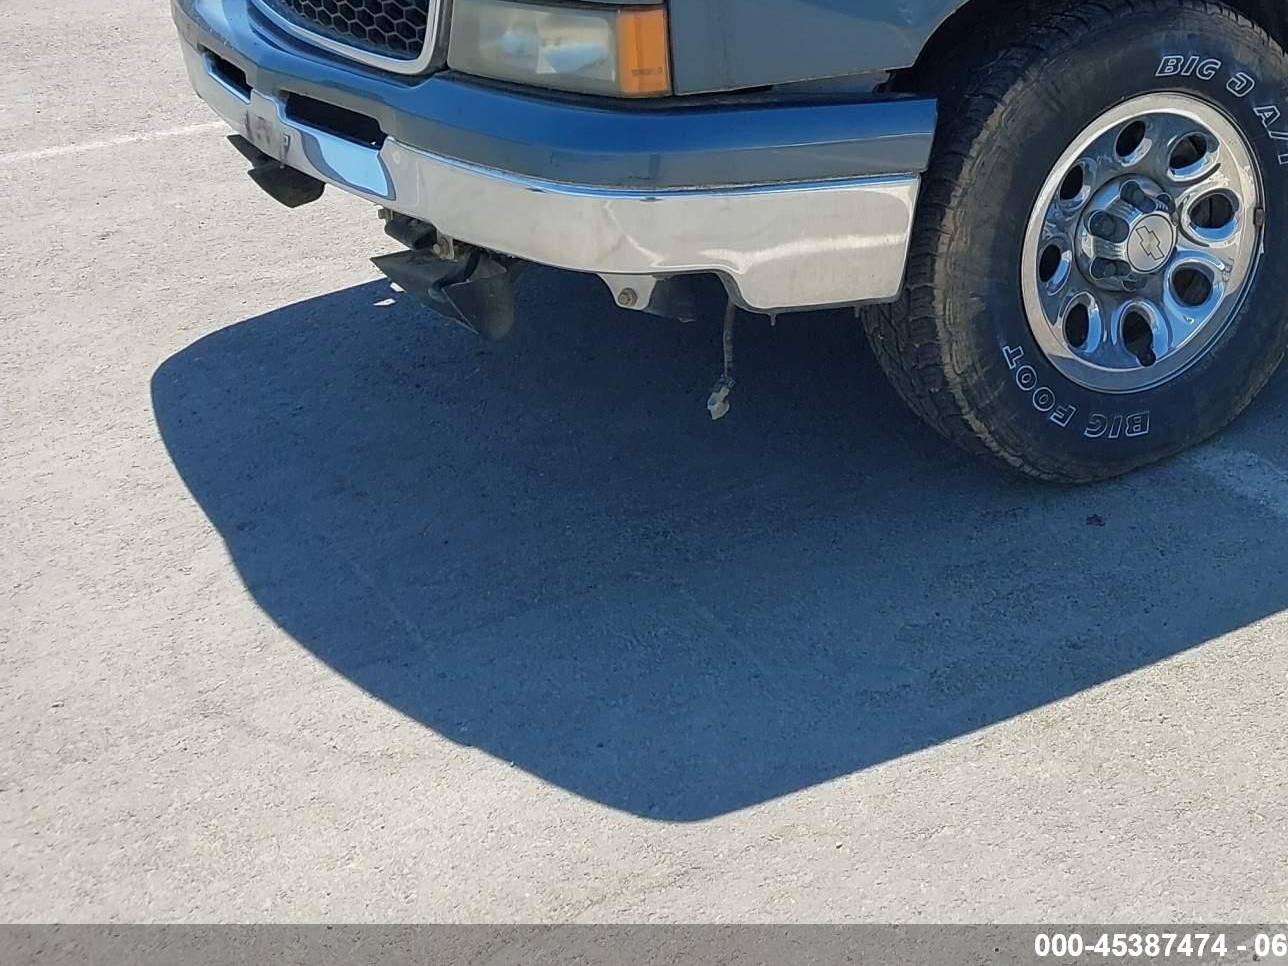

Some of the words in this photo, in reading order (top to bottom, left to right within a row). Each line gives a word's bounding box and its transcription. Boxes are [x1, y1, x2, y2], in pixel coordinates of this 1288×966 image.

[1155, 55, 1222, 81] BIG
[1002, 345, 1077, 428] FOOT
[1083, 410, 1150, 439] BIG
